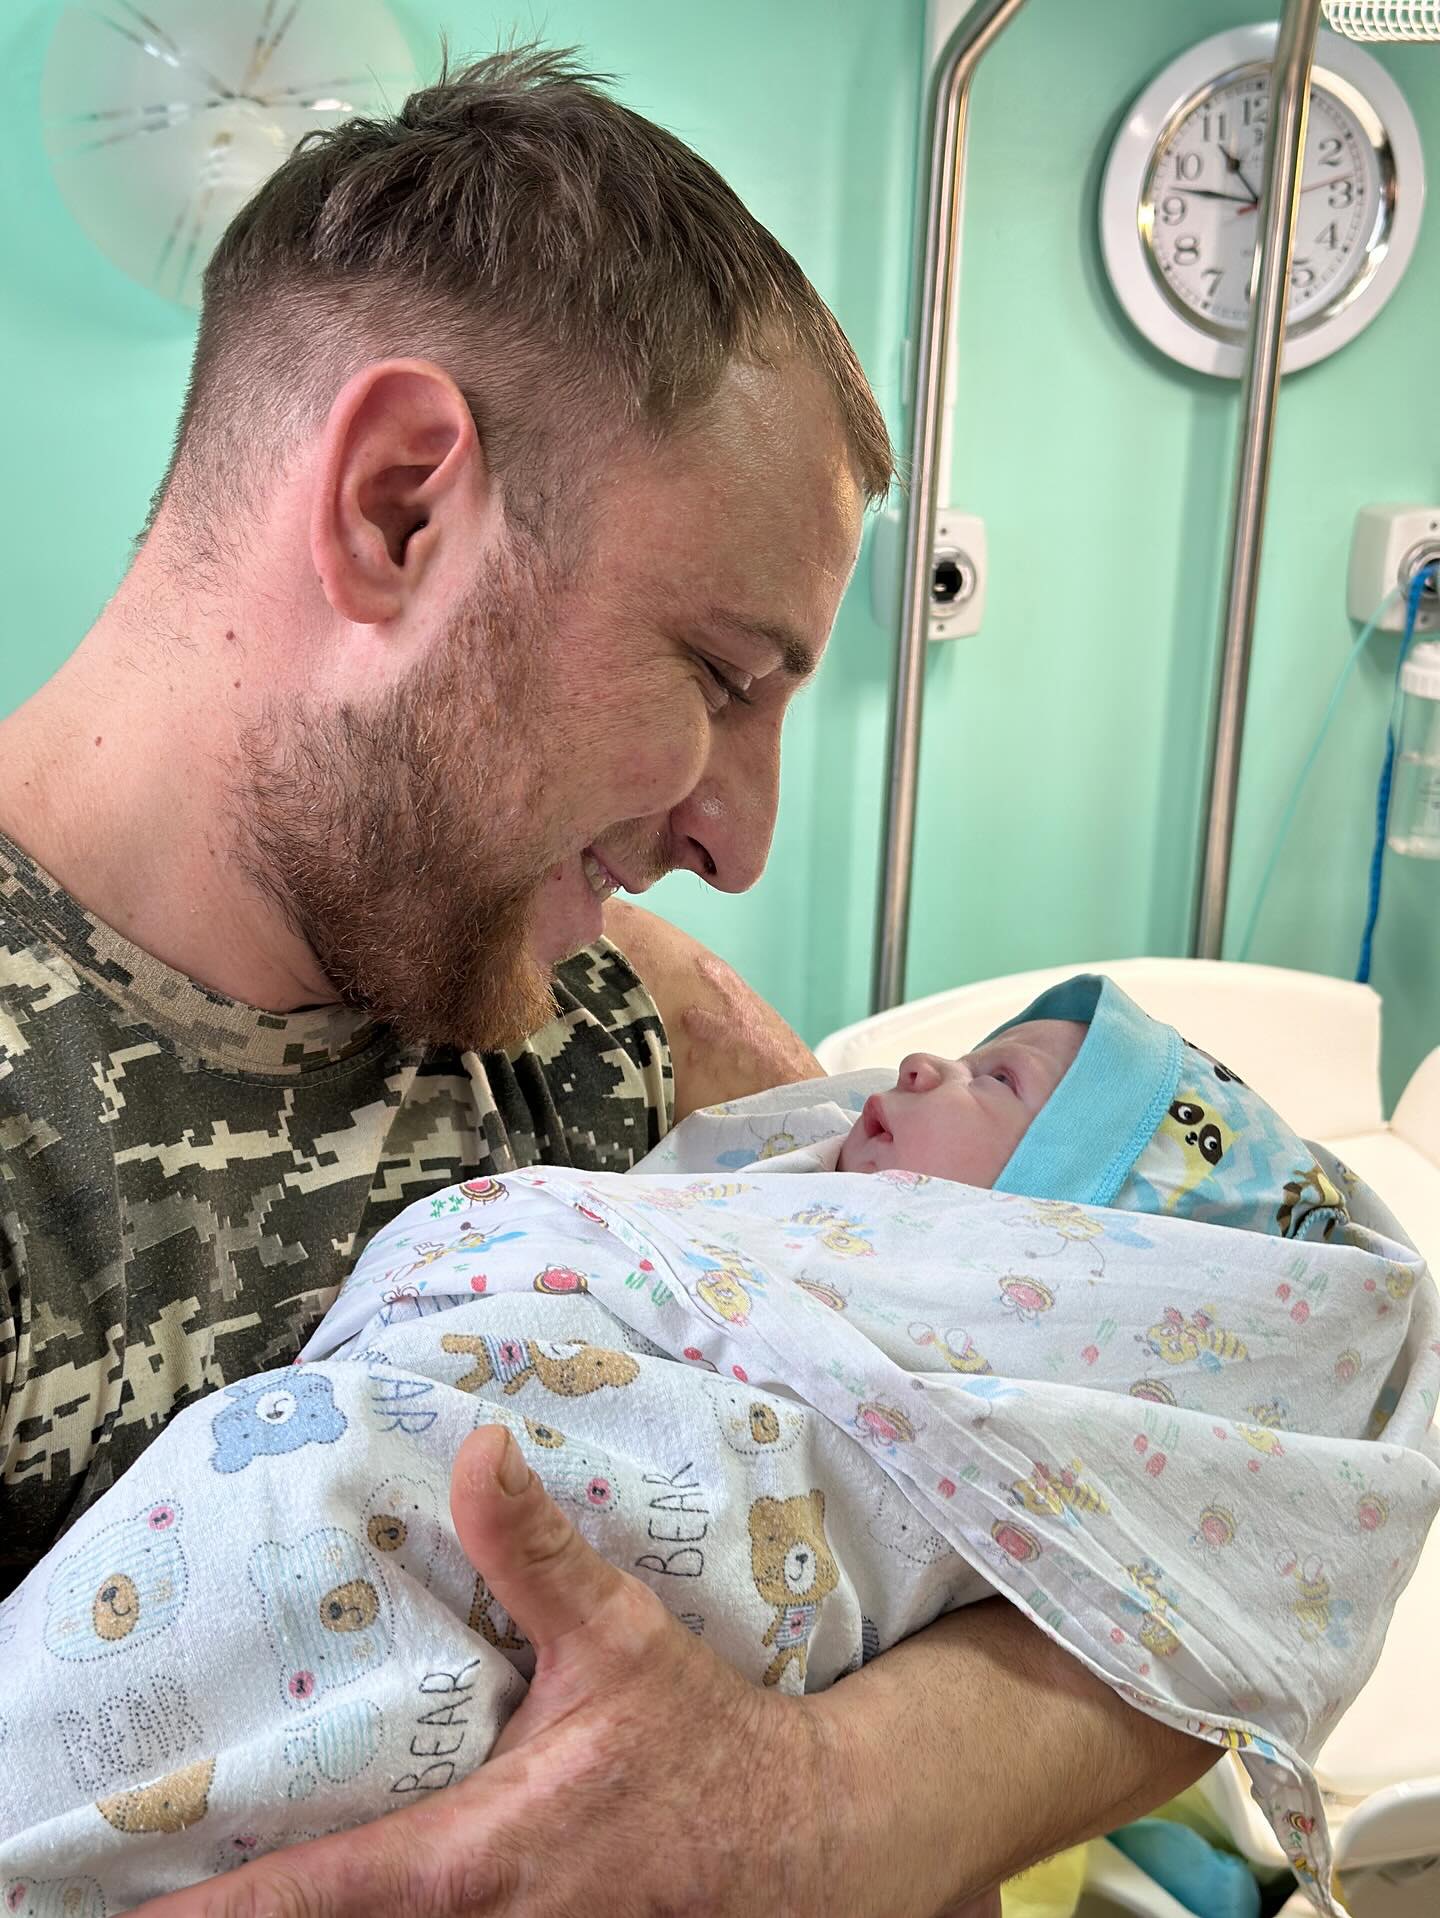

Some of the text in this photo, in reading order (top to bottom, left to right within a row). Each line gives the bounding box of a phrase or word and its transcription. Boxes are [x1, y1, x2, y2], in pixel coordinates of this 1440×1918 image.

[1202, 112, 1227, 142] 11
[1175, 152, 1203, 182] 10
[1319, 139, 1343, 167] 2
[1328, 180, 1353, 210] 3
[1162, 196, 1186, 227] 9
[1173, 235, 1200, 267] 8
[1314, 222, 1338, 250] 4
[1200, 268, 1225, 297] 7
[1291, 257, 1315, 289] 5
[366, 1374, 438, 1434] AR
[635, 1462, 710, 1577] BEAR
[390, 1659, 481, 1793] BEAR
